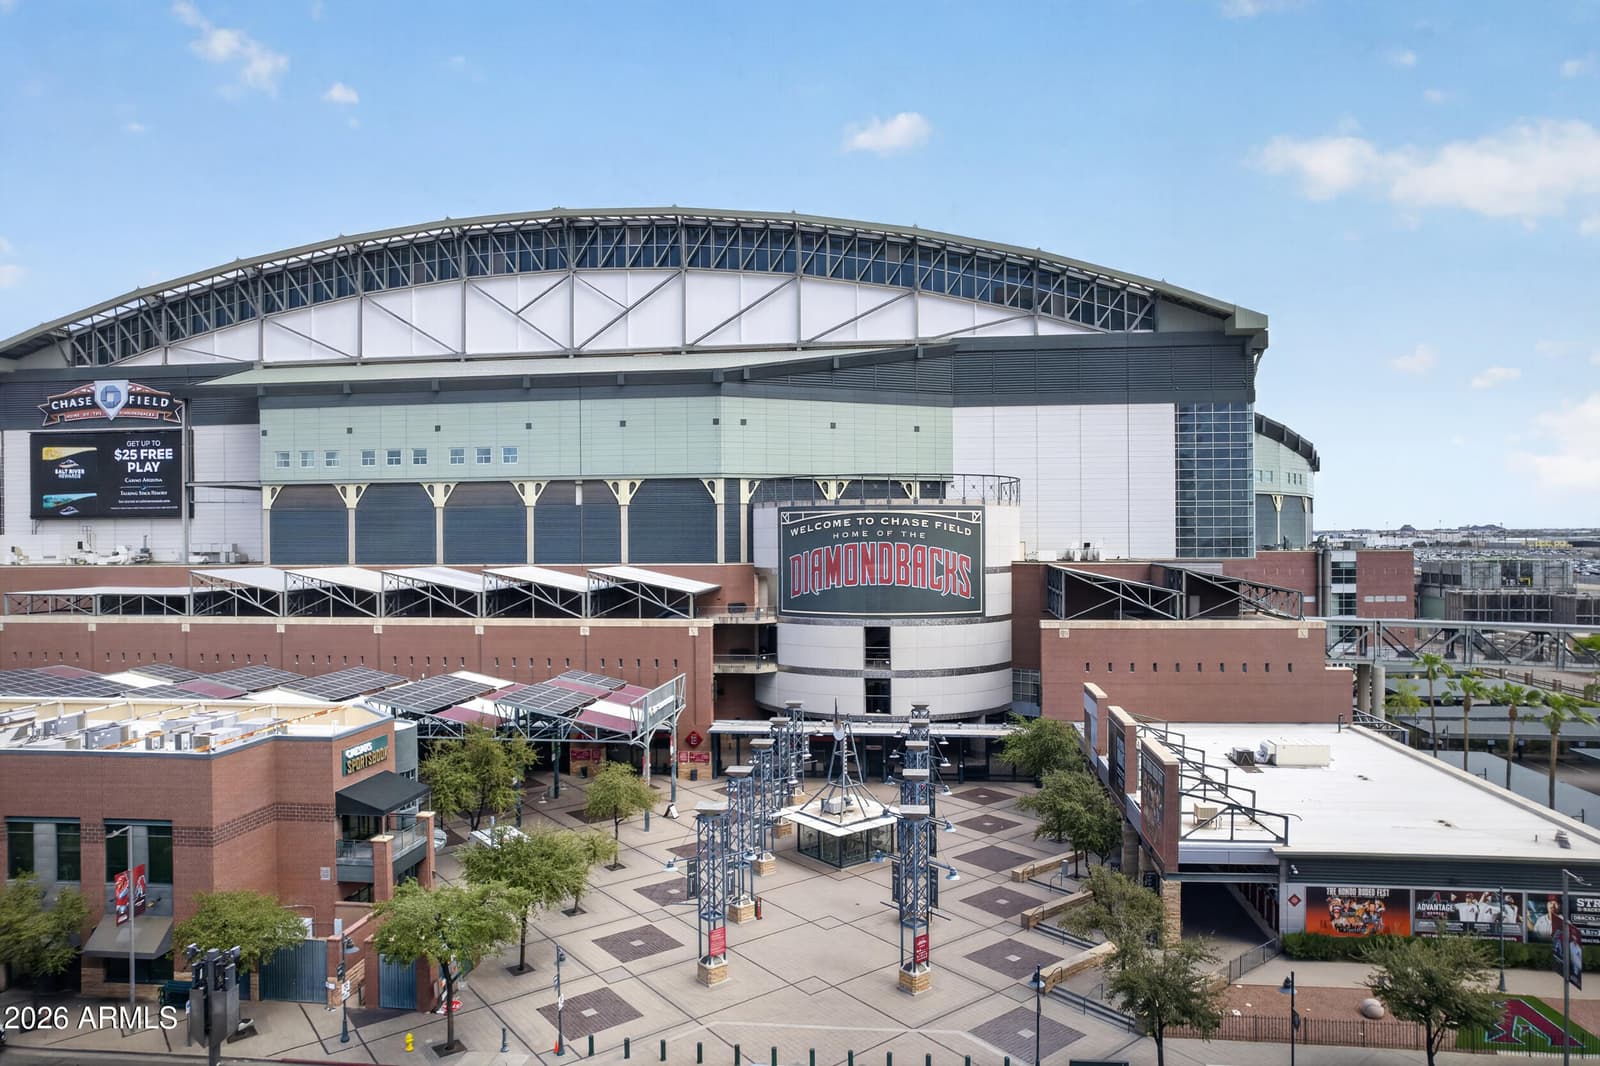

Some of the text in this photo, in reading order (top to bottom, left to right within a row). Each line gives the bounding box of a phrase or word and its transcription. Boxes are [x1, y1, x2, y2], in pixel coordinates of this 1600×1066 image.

[51, 395, 169, 410] CHASE FIELD
[114, 448, 173, 461] $25 FREE
[127, 461, 161, 473] PLAY
[790, 517, 972, 537] WELCOME TO CHASE FIELD
[832, 530, 869, 540] HOME
[901, 530, 926, 539] THE
[789, 541, 972, 600] DIAMONDBACKS
[346, 746, 388, 774] SPORTSBOOK
[1326, 887, 1337, 896] THE
[1376, 888, 1390, 897] FEST
[1416, 903, 1455, 912] ADVANTAGE
